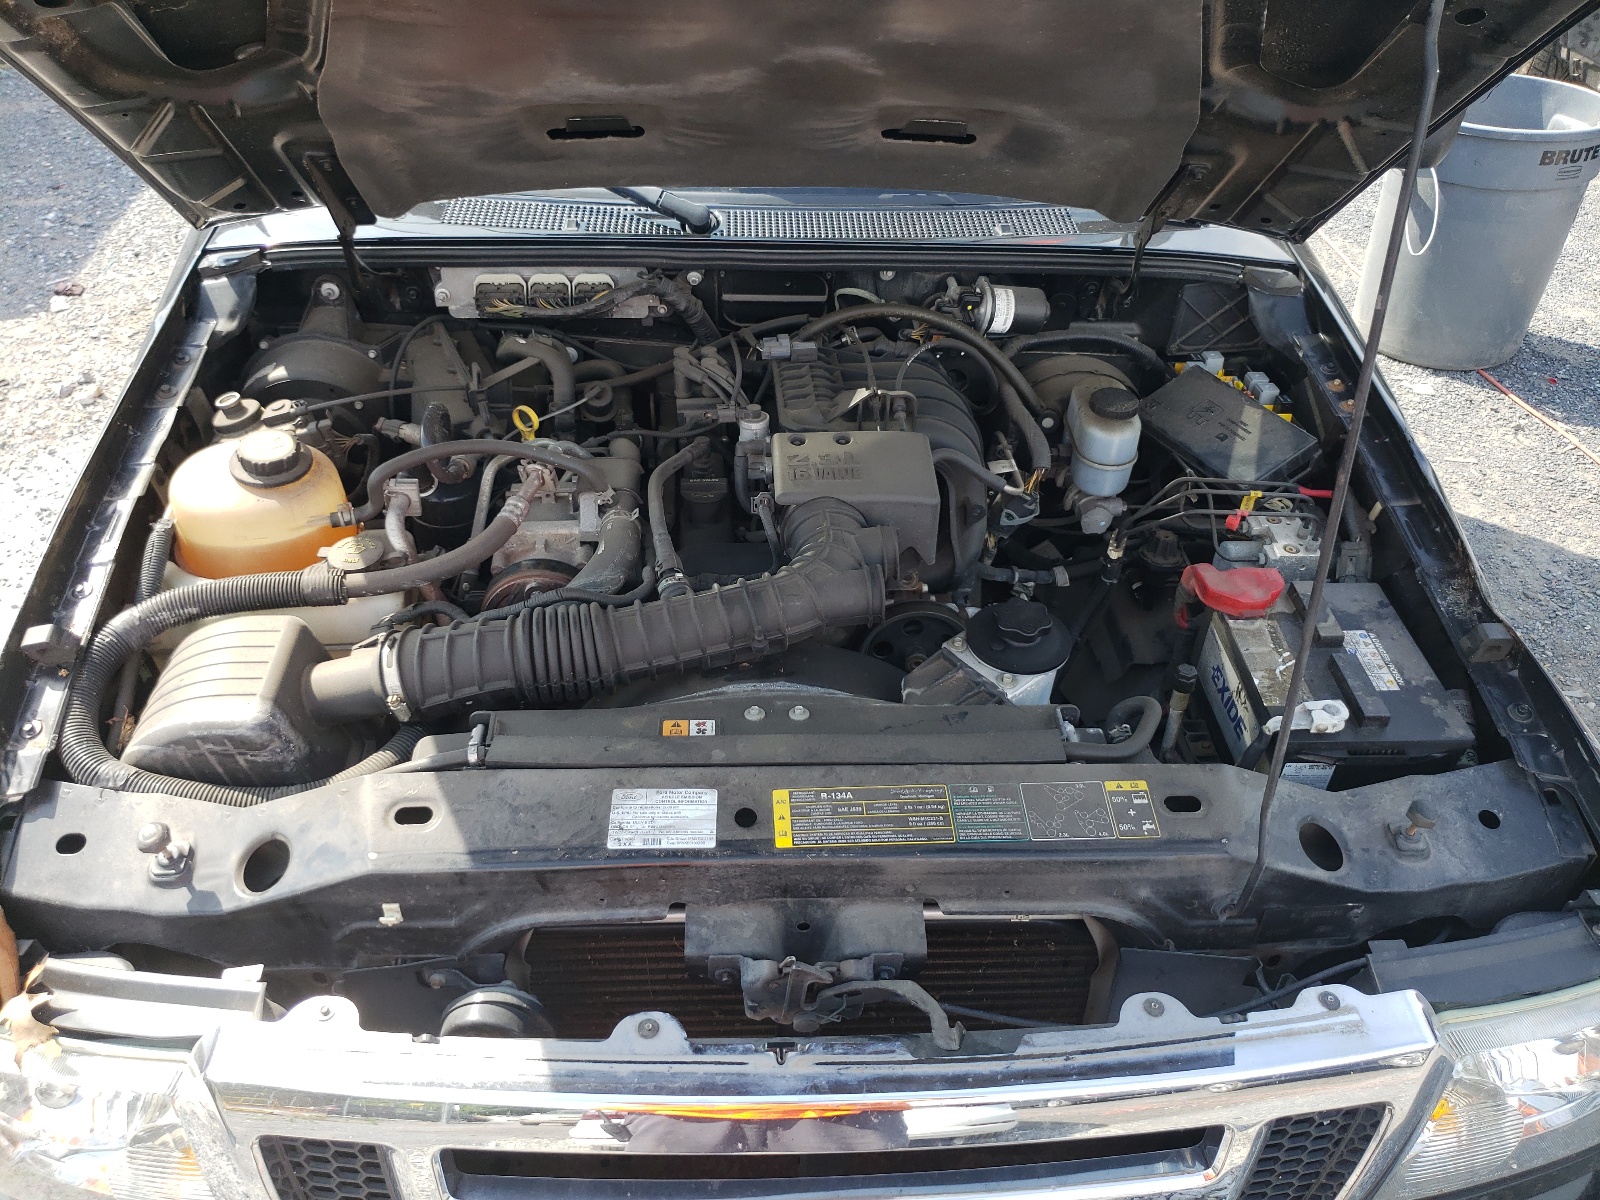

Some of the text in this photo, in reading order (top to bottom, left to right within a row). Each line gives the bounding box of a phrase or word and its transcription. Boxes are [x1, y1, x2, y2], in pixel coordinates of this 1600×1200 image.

[1539, 144, 1600, 166] BRUTE
[1211, 665, 1247, 742] EXIDE
[820, 791, 854, 800] R-134A
